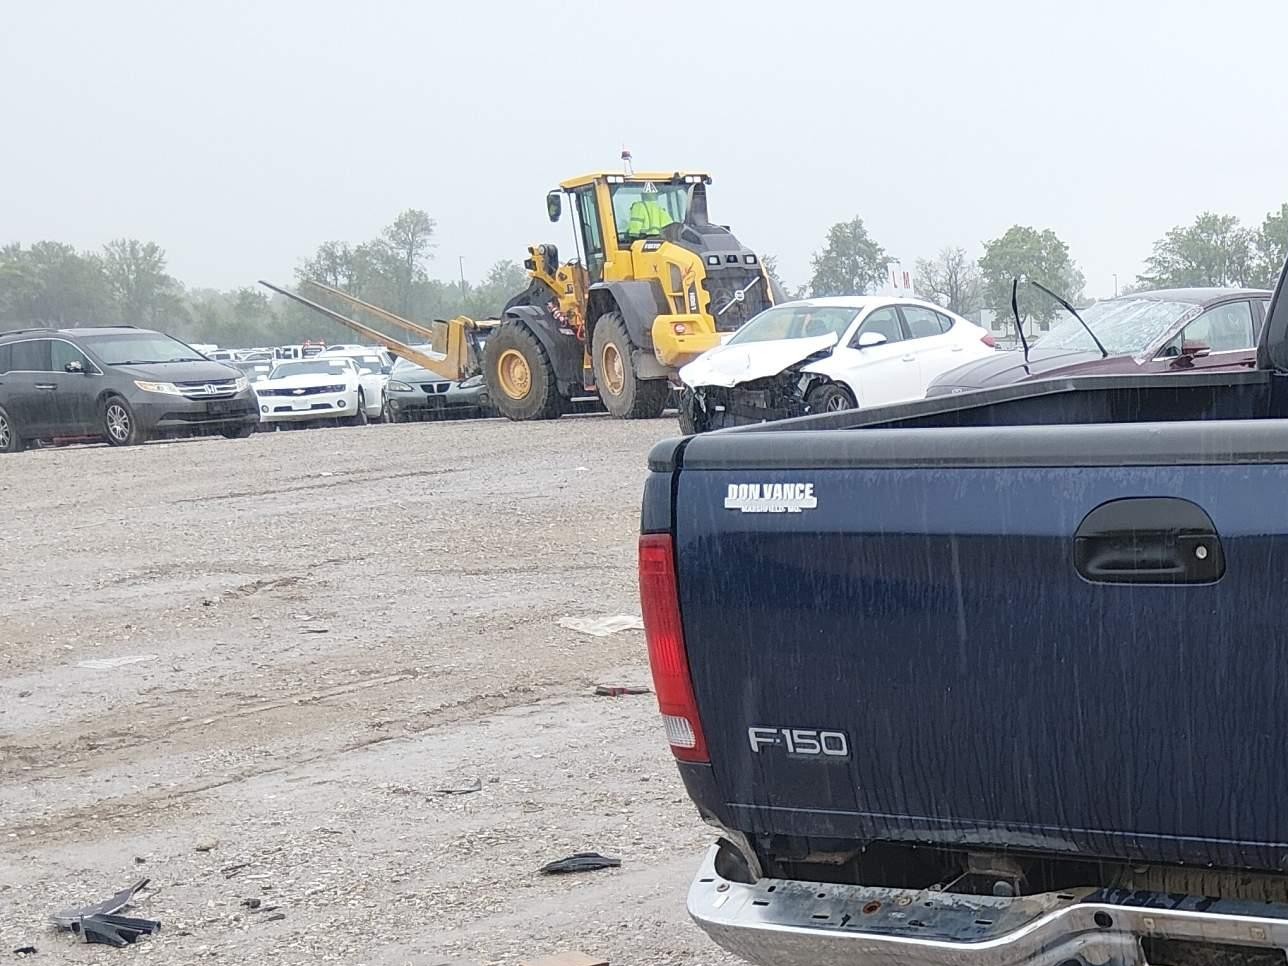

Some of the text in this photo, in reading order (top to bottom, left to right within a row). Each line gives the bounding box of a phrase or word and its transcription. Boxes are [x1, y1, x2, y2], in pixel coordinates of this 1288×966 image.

[728, 483, 814, 499] DON VANCE
[748, 727, 848, 756] F-150
